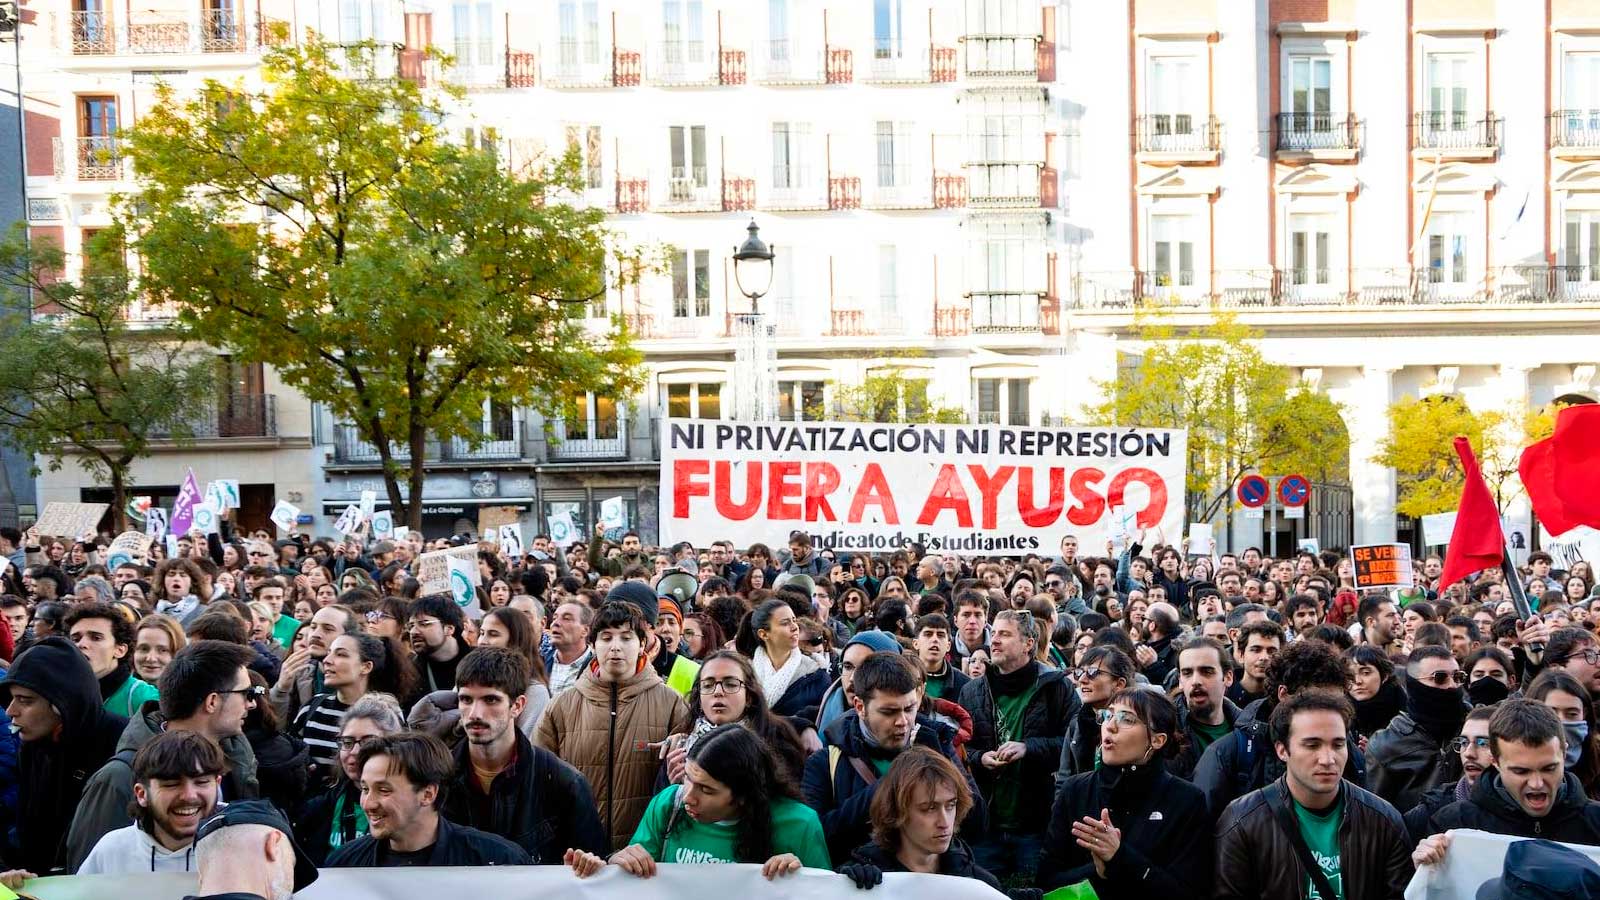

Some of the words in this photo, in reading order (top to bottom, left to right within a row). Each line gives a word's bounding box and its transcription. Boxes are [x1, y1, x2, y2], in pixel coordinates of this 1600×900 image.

[672, 424, 704, 449] NI
[716, 425, 945, 453] PRIVATIZACIÓN
[955, 429, 990, 454] NI
[1000, 428, 1171, 457] REPRESIÓN
[673, 459, 899, 525] FUERA
[916, 464, 1168, 530] AYUSO
[789, 530, 886, 549] ndicato
[889, 531, 913, 550] de
[919, 533, 1039, 551] Estudiantes
[1356, 549, 1371, 561] SE
[1375, 547, 1409, 560] VENDE
